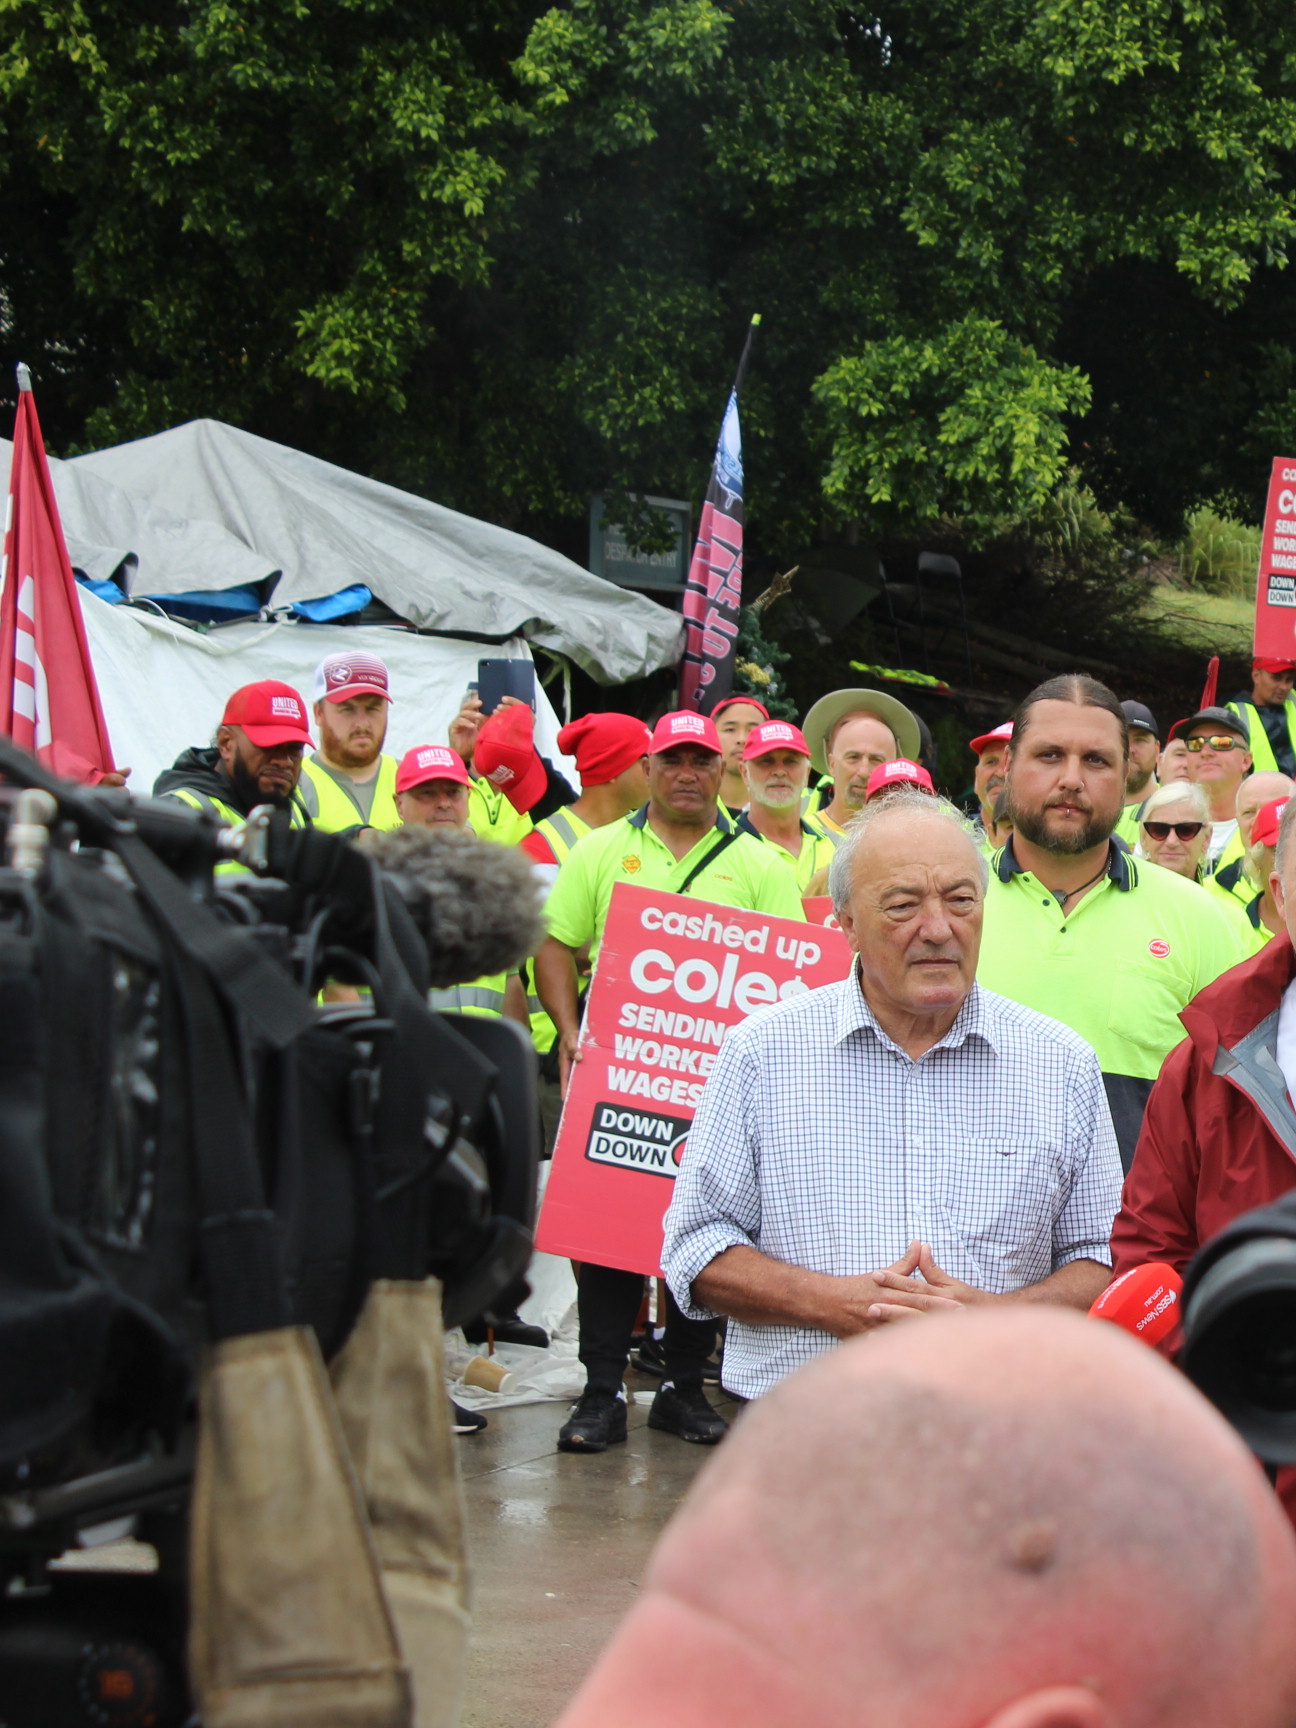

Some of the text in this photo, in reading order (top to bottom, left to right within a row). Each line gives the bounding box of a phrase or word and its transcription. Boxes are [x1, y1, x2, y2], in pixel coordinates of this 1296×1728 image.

[1270, 576, 1295, 588] DOWN
[1269, 591, 1294, 602] DOWN
[272, 696, 299, 710] UNITED
[671, 716, 704, 728] UNITED
[760, 724, 792, 736] UNITED
[417, 748, 451, 762] UNITED
[885, 761, 917, 772] UNITED
[640, 906, 821, 968] cashed up
[614, 1033, 719, 1078] WORKE
[607, 1065, 704, 1110] WAGES
[600, 1108, 674, 1141] DOWN
[594, 1135, 669, 1167] DOWN
